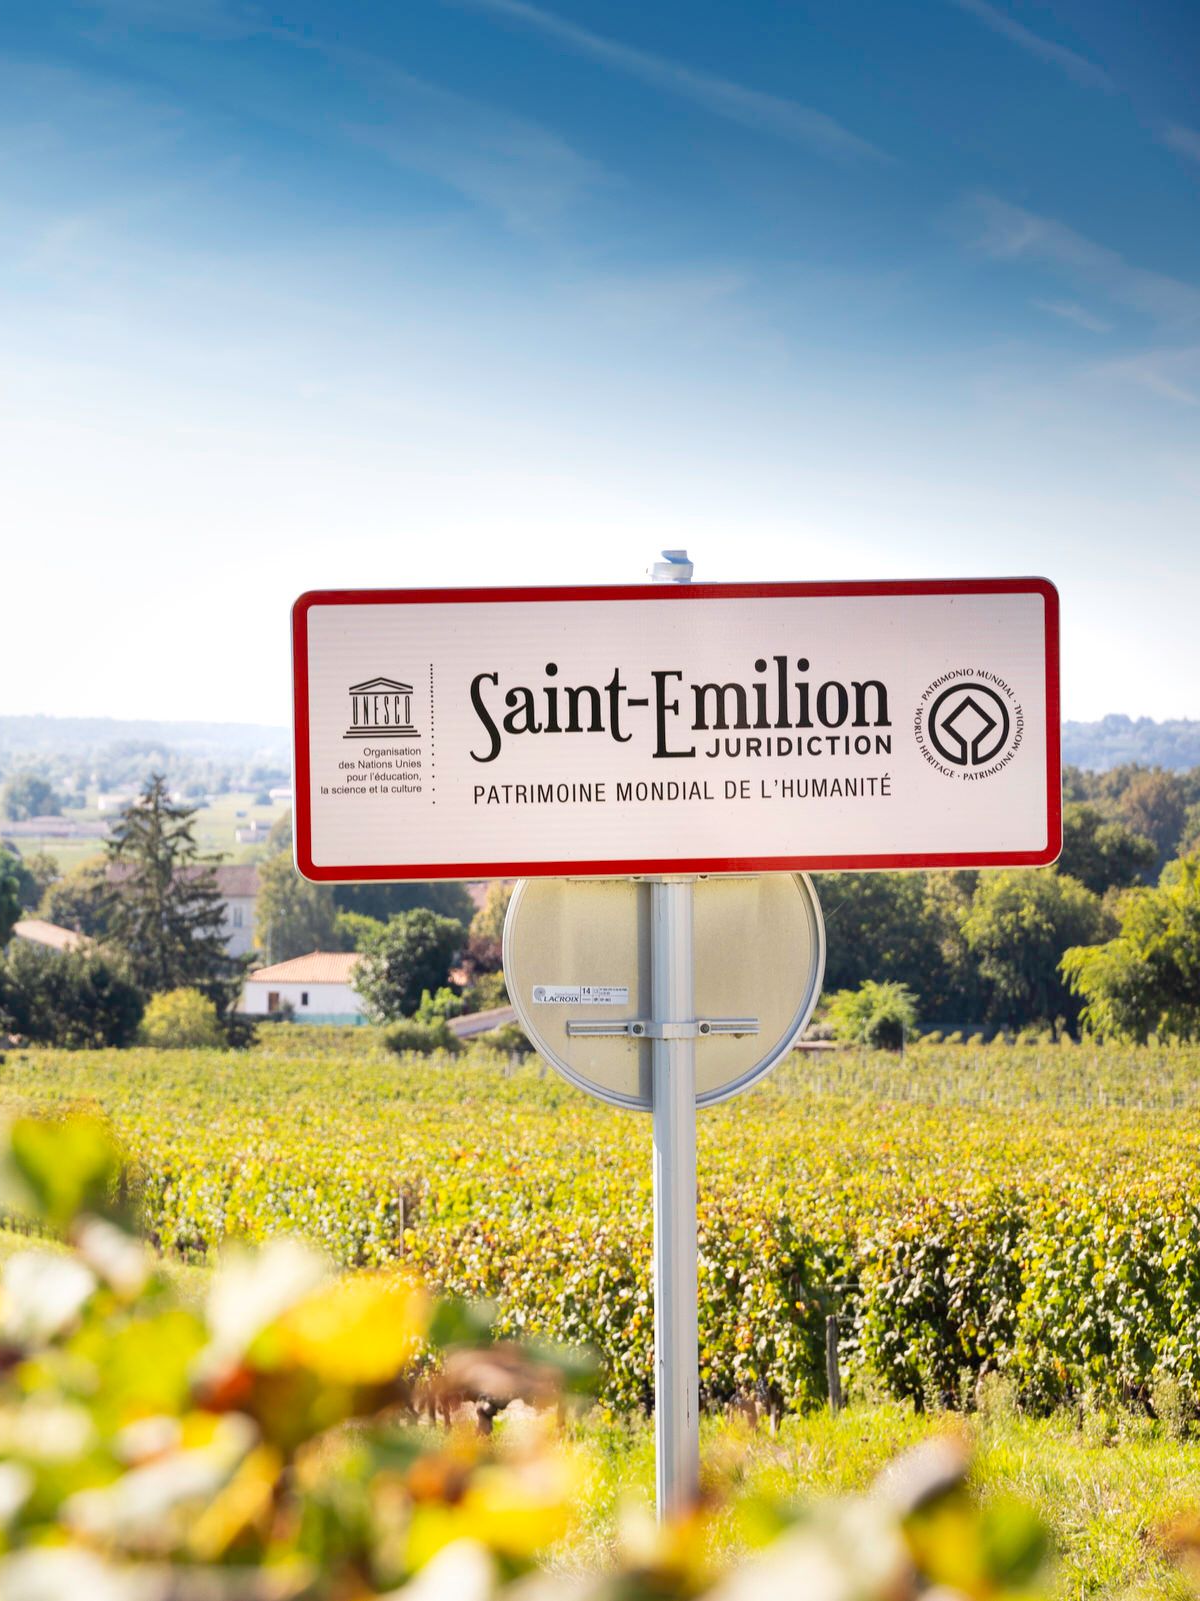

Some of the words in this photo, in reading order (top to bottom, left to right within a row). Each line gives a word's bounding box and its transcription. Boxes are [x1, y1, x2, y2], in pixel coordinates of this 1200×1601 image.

[921, 668, 974, 701] PATRIMONIO
[976, 669, 1015, 699] MUNDIAL
[352, 695, 411, 725] UNESCO
[469, 655, 892, 763] Saint-Emilion
[363, 746, 422, 758] Organisation
[705, 734, 892, 759] JURIDICTION
[914, 707, 924, 744] WORLD
[920, 744, 955, 778] HERITAGE
[963, 751, 1014, 781] PATRIMOINE
[1012, 704, 1024, 751] MONDIAL
[338, 760, 355, 769] des
[357, 760, 393, 769] Nations
[395, 759, 422, 768] Unies
[346, 774, 367, 783] pour
[369, 771, 422, 781] l'éducation,
[320, 786, 329, 795] la
[331, 785, 366, 795] science
[369, 785, 378, 794] et
[380, 784, 389, 793] la
[391, 783, 422, 793] culture
[473, 782, 606, 805] PATRIMOINE
[616, 780, 715, 802] MONDIAL
[724, 779, 751, 800] DE
[761, 772, 892, 799] L'HUMANITÉ
